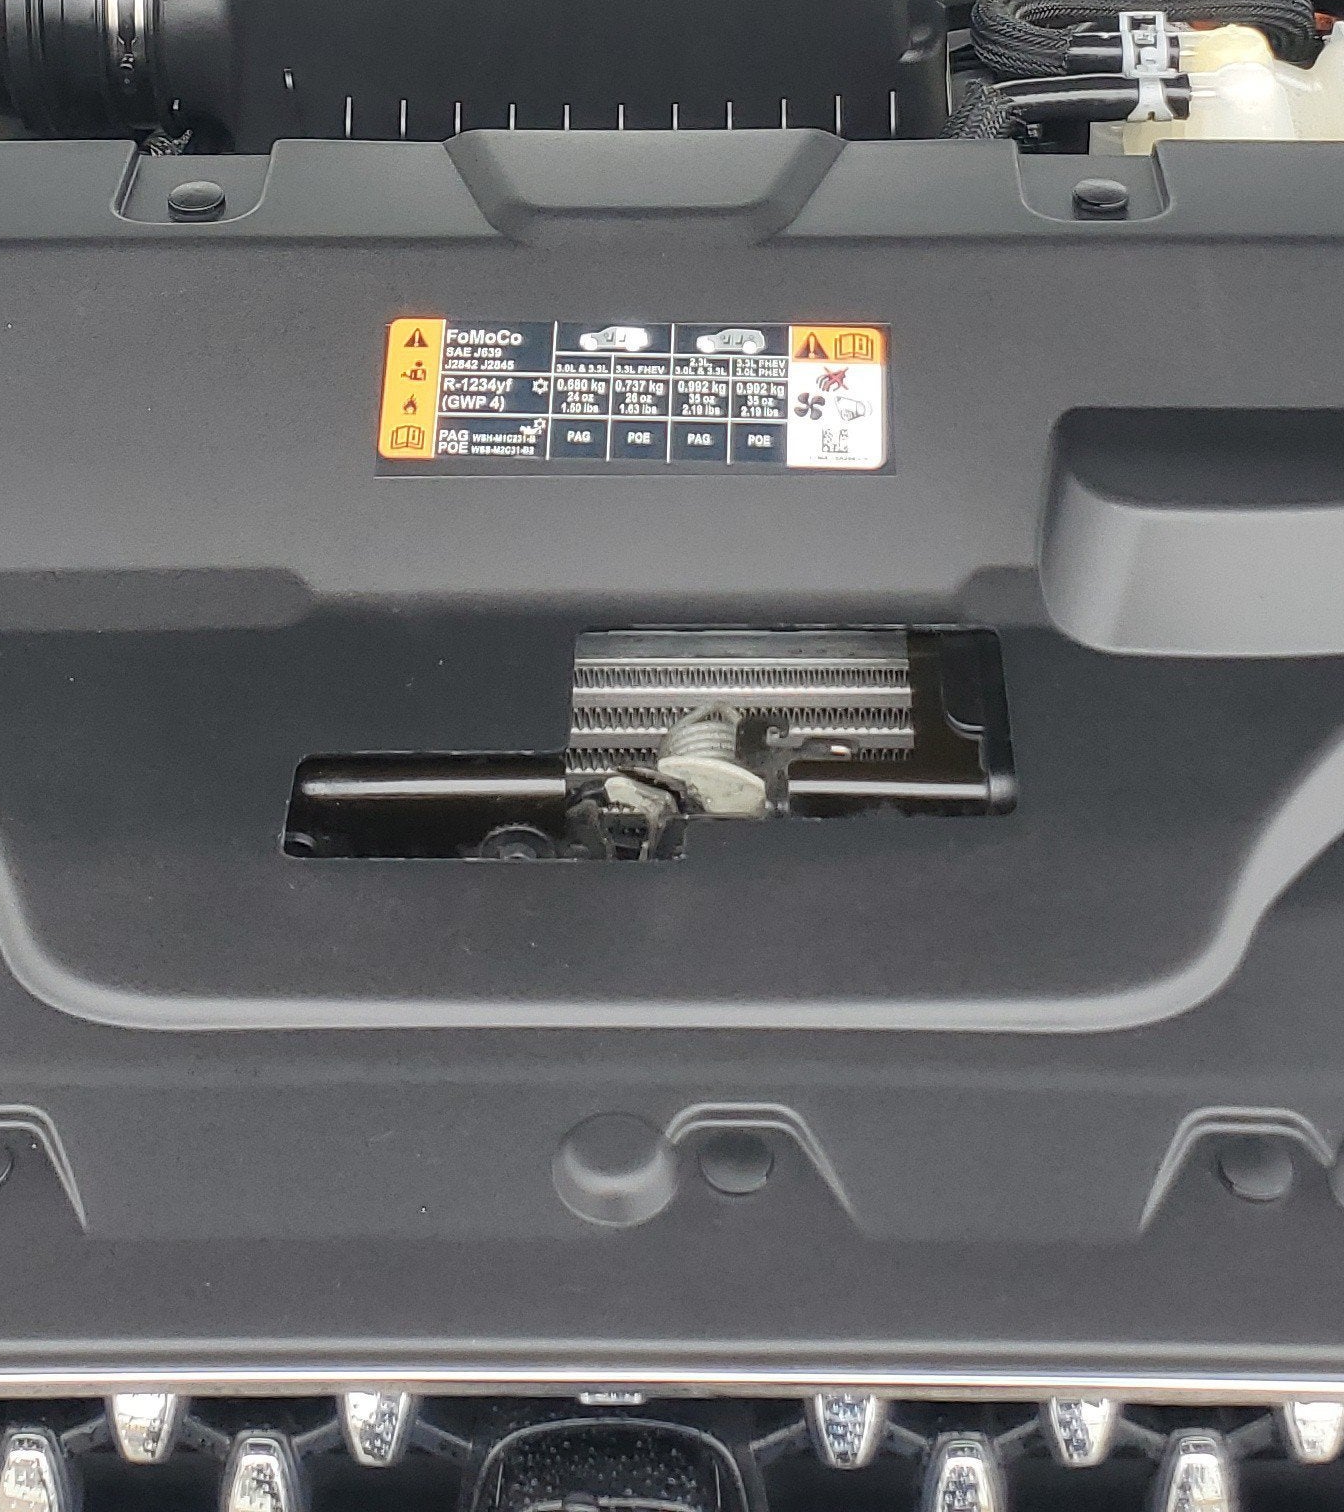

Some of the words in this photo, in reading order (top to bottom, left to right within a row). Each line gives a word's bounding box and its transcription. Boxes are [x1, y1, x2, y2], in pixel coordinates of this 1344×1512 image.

[446, 329, 523, 345] FoMoCo
[446, 347, 472, 357] SAE
[473, 347, 502, 358] J639
[444, 359, 479, 369] J2842
[480, 360, 515, 370] J2845
[615, 365, 636, 374] 3.3L
[443, 377, 514, 395] R-1234yf
[591, 379, 606, 394] kg
[615, 379, 646, 392] 0.737
[648, 380, 664, 395] kg
[711, 380, 726, 396] kg
[770, 382, 785, 399] kg
[567, 392, 580, 402] 24
[581, 393, 595, 403] oz
[639, 394, 653, 403] oz
[703, 395, 716, 405] oz
[747, 395, 759, 406] 35
[761, 397, 775, 406] oz
[441, 395, 488, 412] (GWP
[489, 395, 506, 413] 4)
[583, 402, 599, 414] lbs
[641, 403, 657, 415] lbs
[705, 404, 721, 416] lbs
[764, 406, 780, 417] lbs
[438, 429, 469, 442] PAG
[567, 430, 591, 443] PAG
[627, 431, 651, 444] POE
[687, 433, 712, 445] PAG
[747, 434, 771, 447] POE
[437, 442, 469, 454] POE
